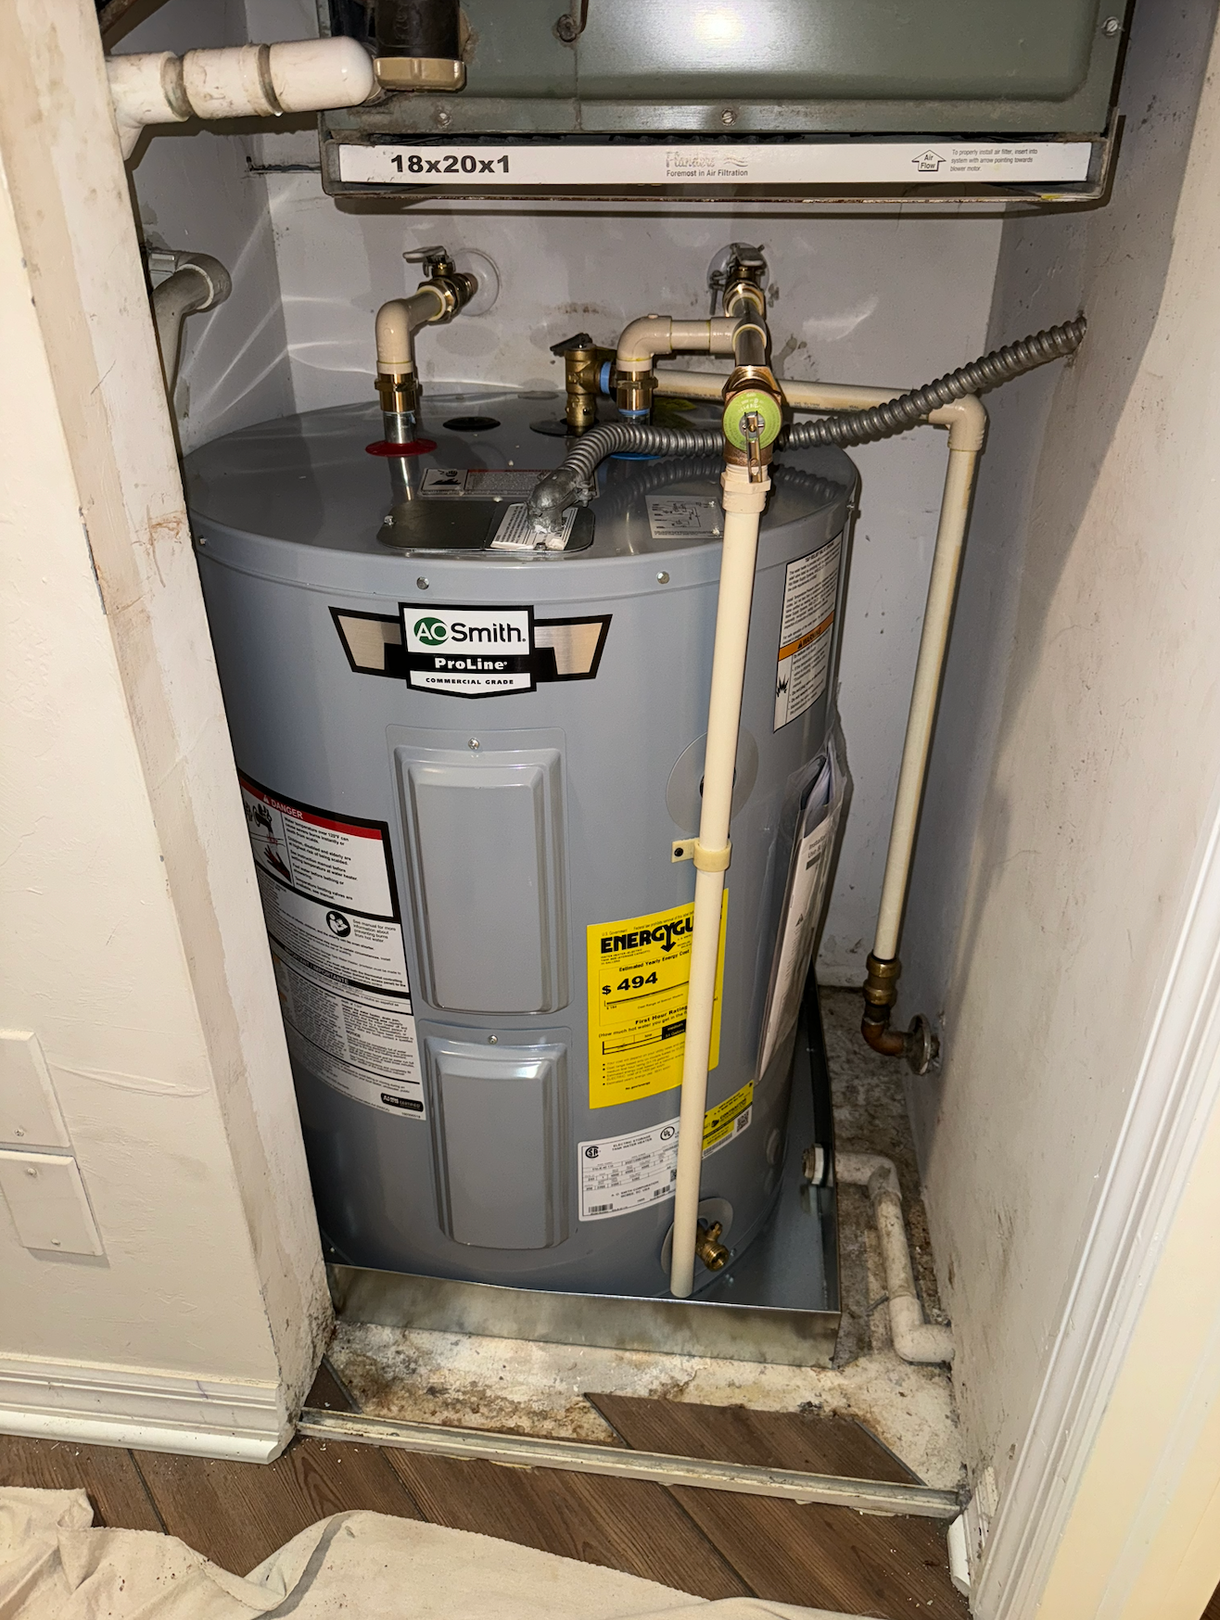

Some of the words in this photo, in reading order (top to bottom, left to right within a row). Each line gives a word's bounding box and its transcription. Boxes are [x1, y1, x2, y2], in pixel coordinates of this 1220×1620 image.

[390, 154, 510, 174] 18x20x1
[666, 169, 697, 177] Foremost
[425, 677, 482, 685] COMMERCIAL
[271, 799, 304, 820] DANGER
[353, 924, 376, 933] information
[361, 921, 377, 929] manual
[354, 929, 376, 938] preventing
[619, 963, 644, 972] Estimated
[645, 957, 661, 966] Yearly
[662, 952, 679, 962] Energy
[601, 984, 612, 996] $
[617, 971, 658, 991] 494
[635, 1017, 650, 1025] First
[652, 1013, 667, 1021] Hour
[668, 1005, 688, 1015] Rating
[637, 1022, 652, 1030] water
